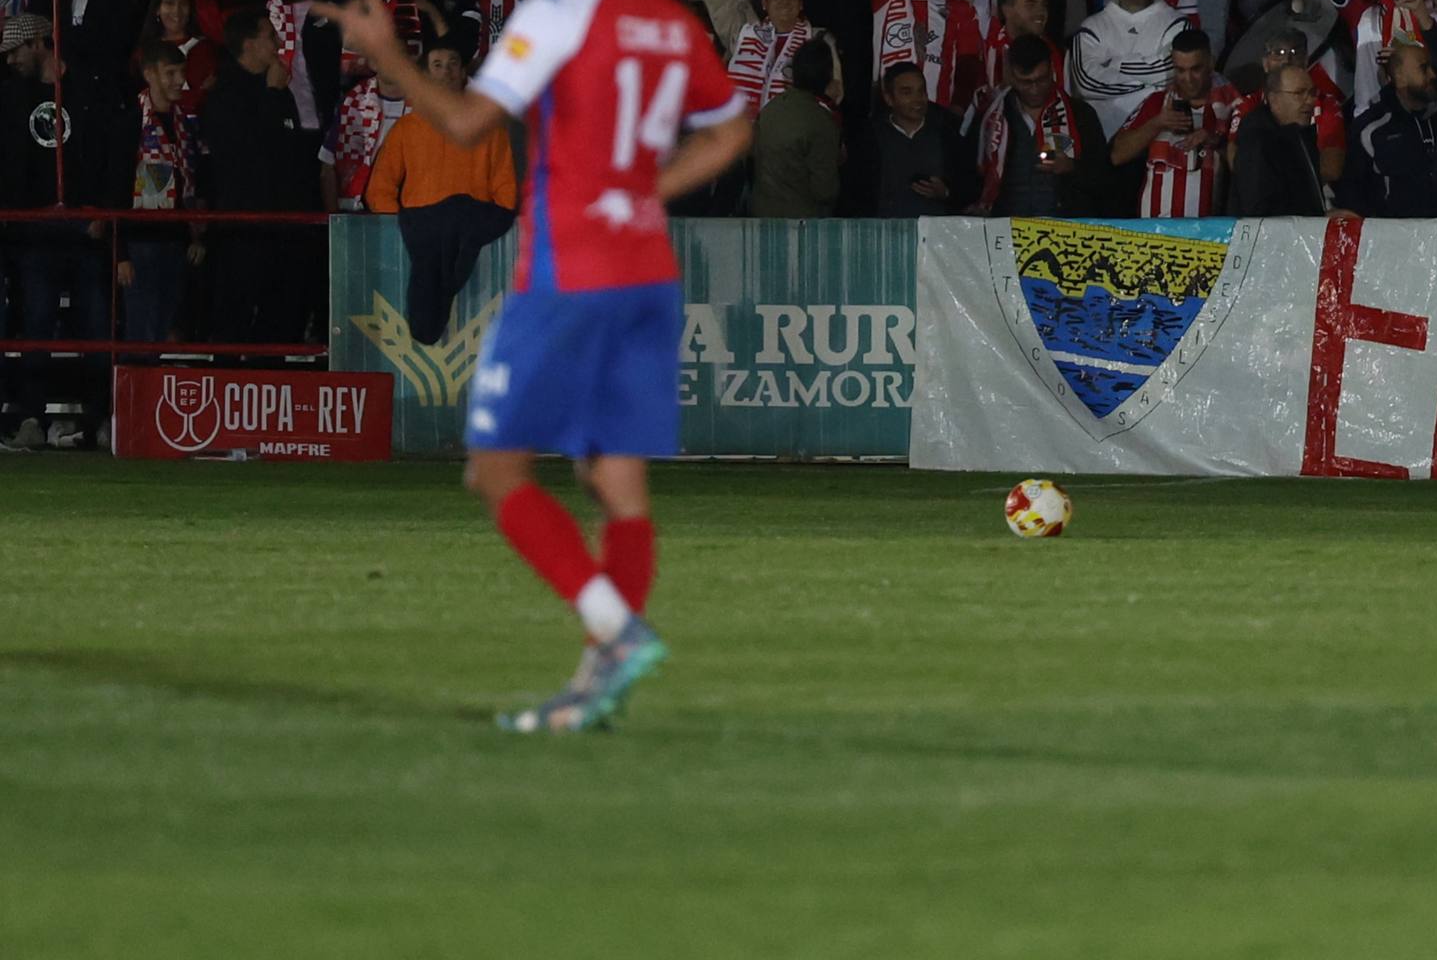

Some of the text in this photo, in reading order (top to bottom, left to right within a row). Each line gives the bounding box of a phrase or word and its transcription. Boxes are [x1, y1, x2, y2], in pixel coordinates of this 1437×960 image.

[735, 37, 768, 71] REY
[610, 55, 690, 171] 14
[224, 382, 368, 434] COPA DEL REY
[720, 369, 917, 408] ZAMOR
[259, 441, 331, 457] MAPFRE
